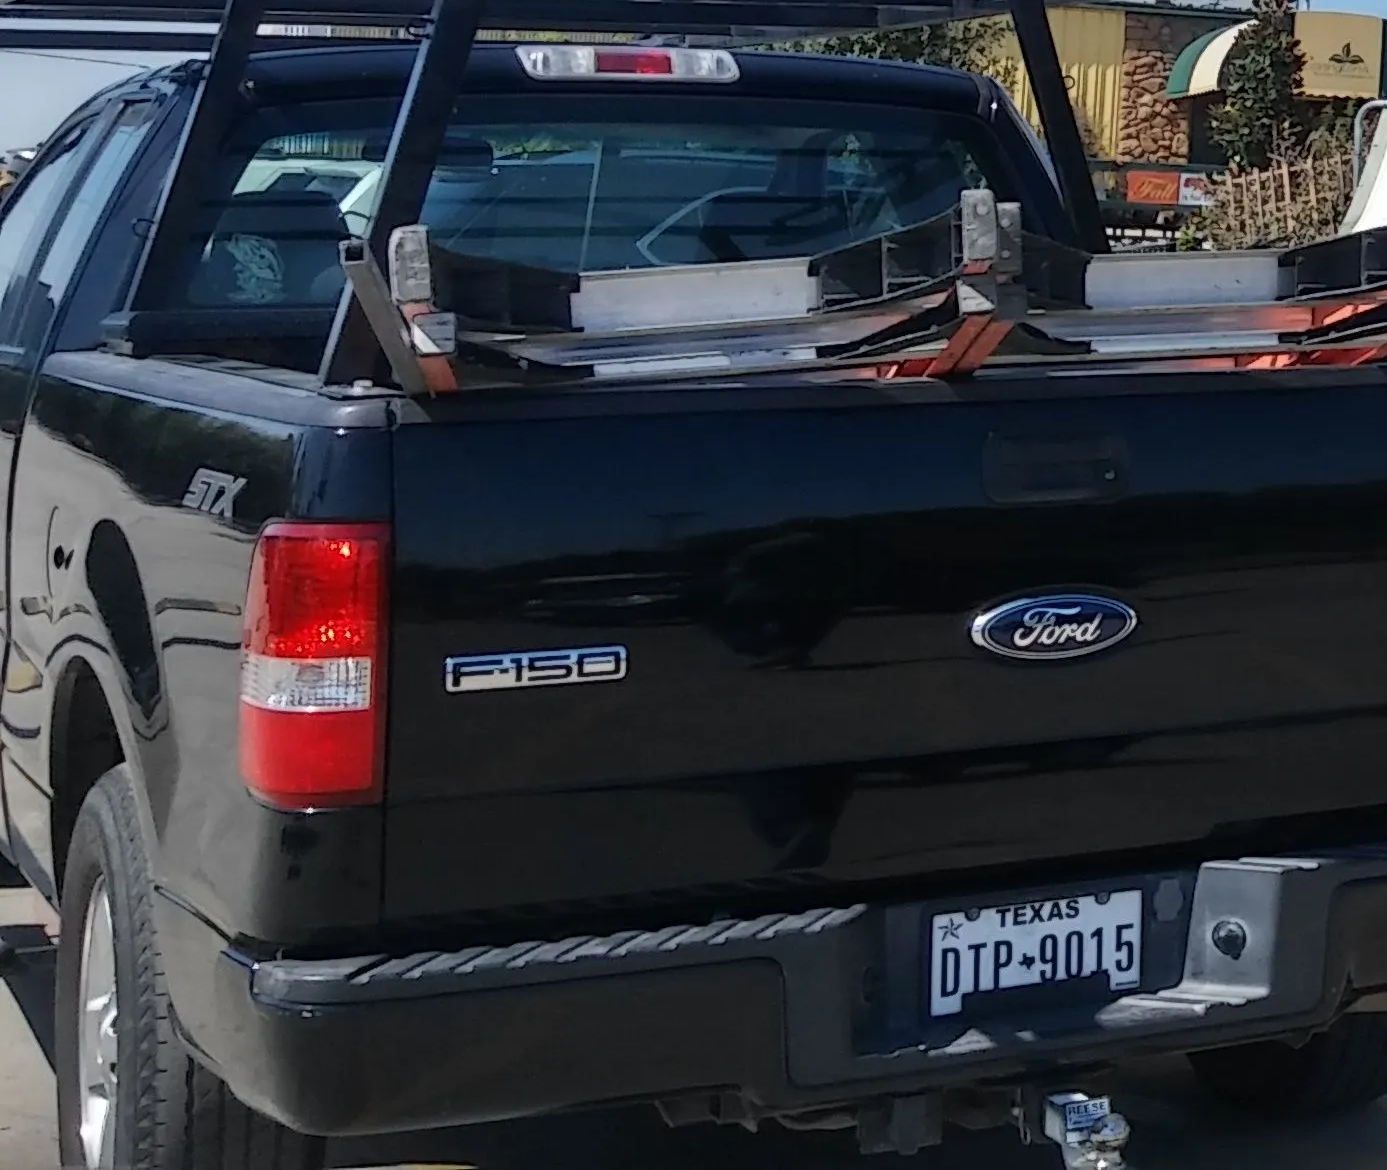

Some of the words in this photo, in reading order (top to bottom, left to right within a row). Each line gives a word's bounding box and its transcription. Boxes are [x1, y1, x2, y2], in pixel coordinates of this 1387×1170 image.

[182, 467, 249, 518] STX
[1013, 606, 1104, 647] Ford
[451, 650, 622, 688] F-150
[996, 898, 1080, 928] TEXAS
